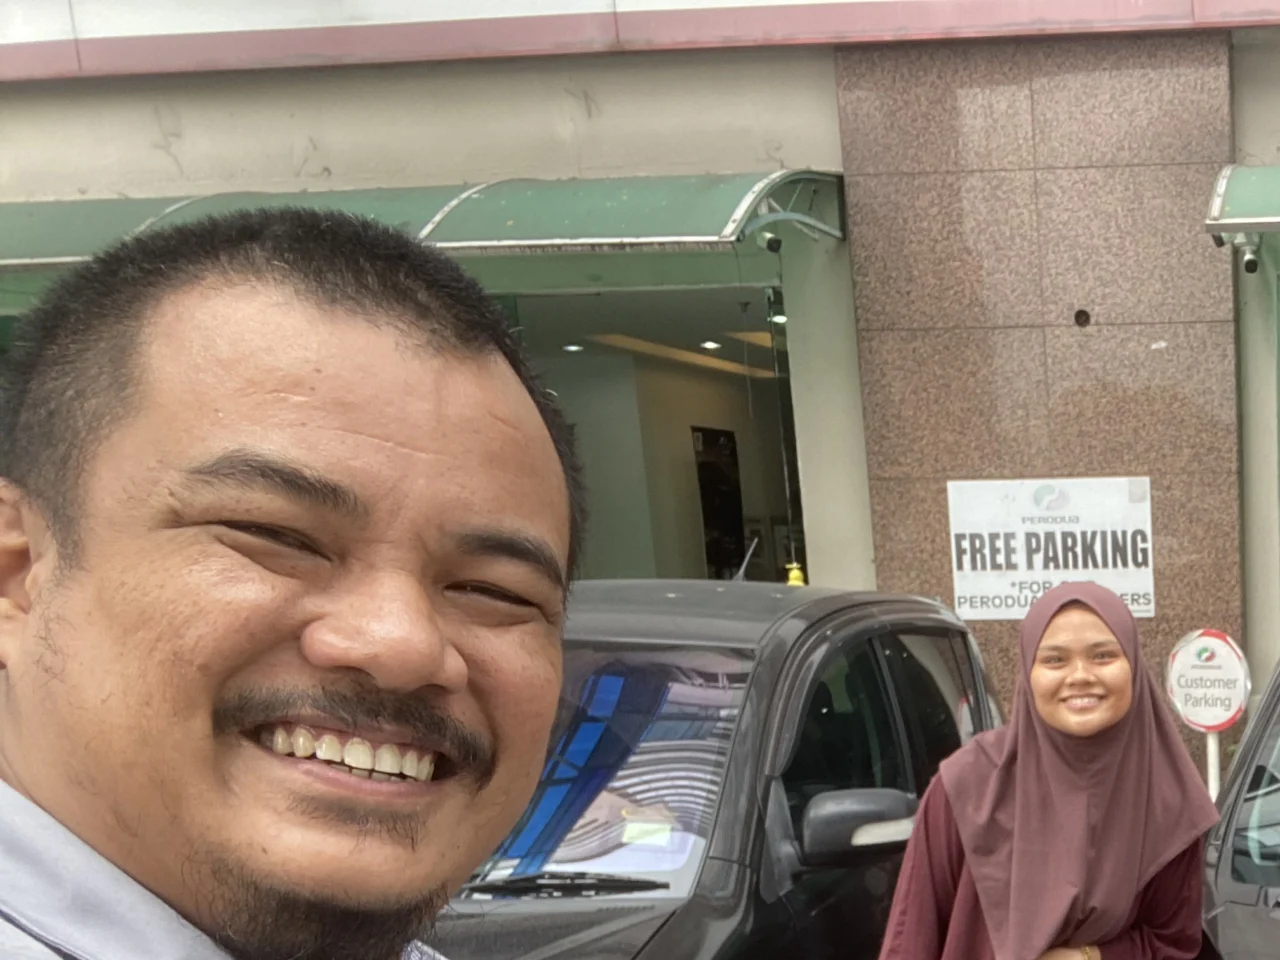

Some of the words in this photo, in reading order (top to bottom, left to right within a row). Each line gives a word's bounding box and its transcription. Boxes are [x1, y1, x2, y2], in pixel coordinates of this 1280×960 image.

[954, 531, 1018, 571] FREE
[1025, 528, 1150, 571] PARKING
[1177, 674, 1239, 690] Customer
[1184, 692, 1232, 712] Parking
